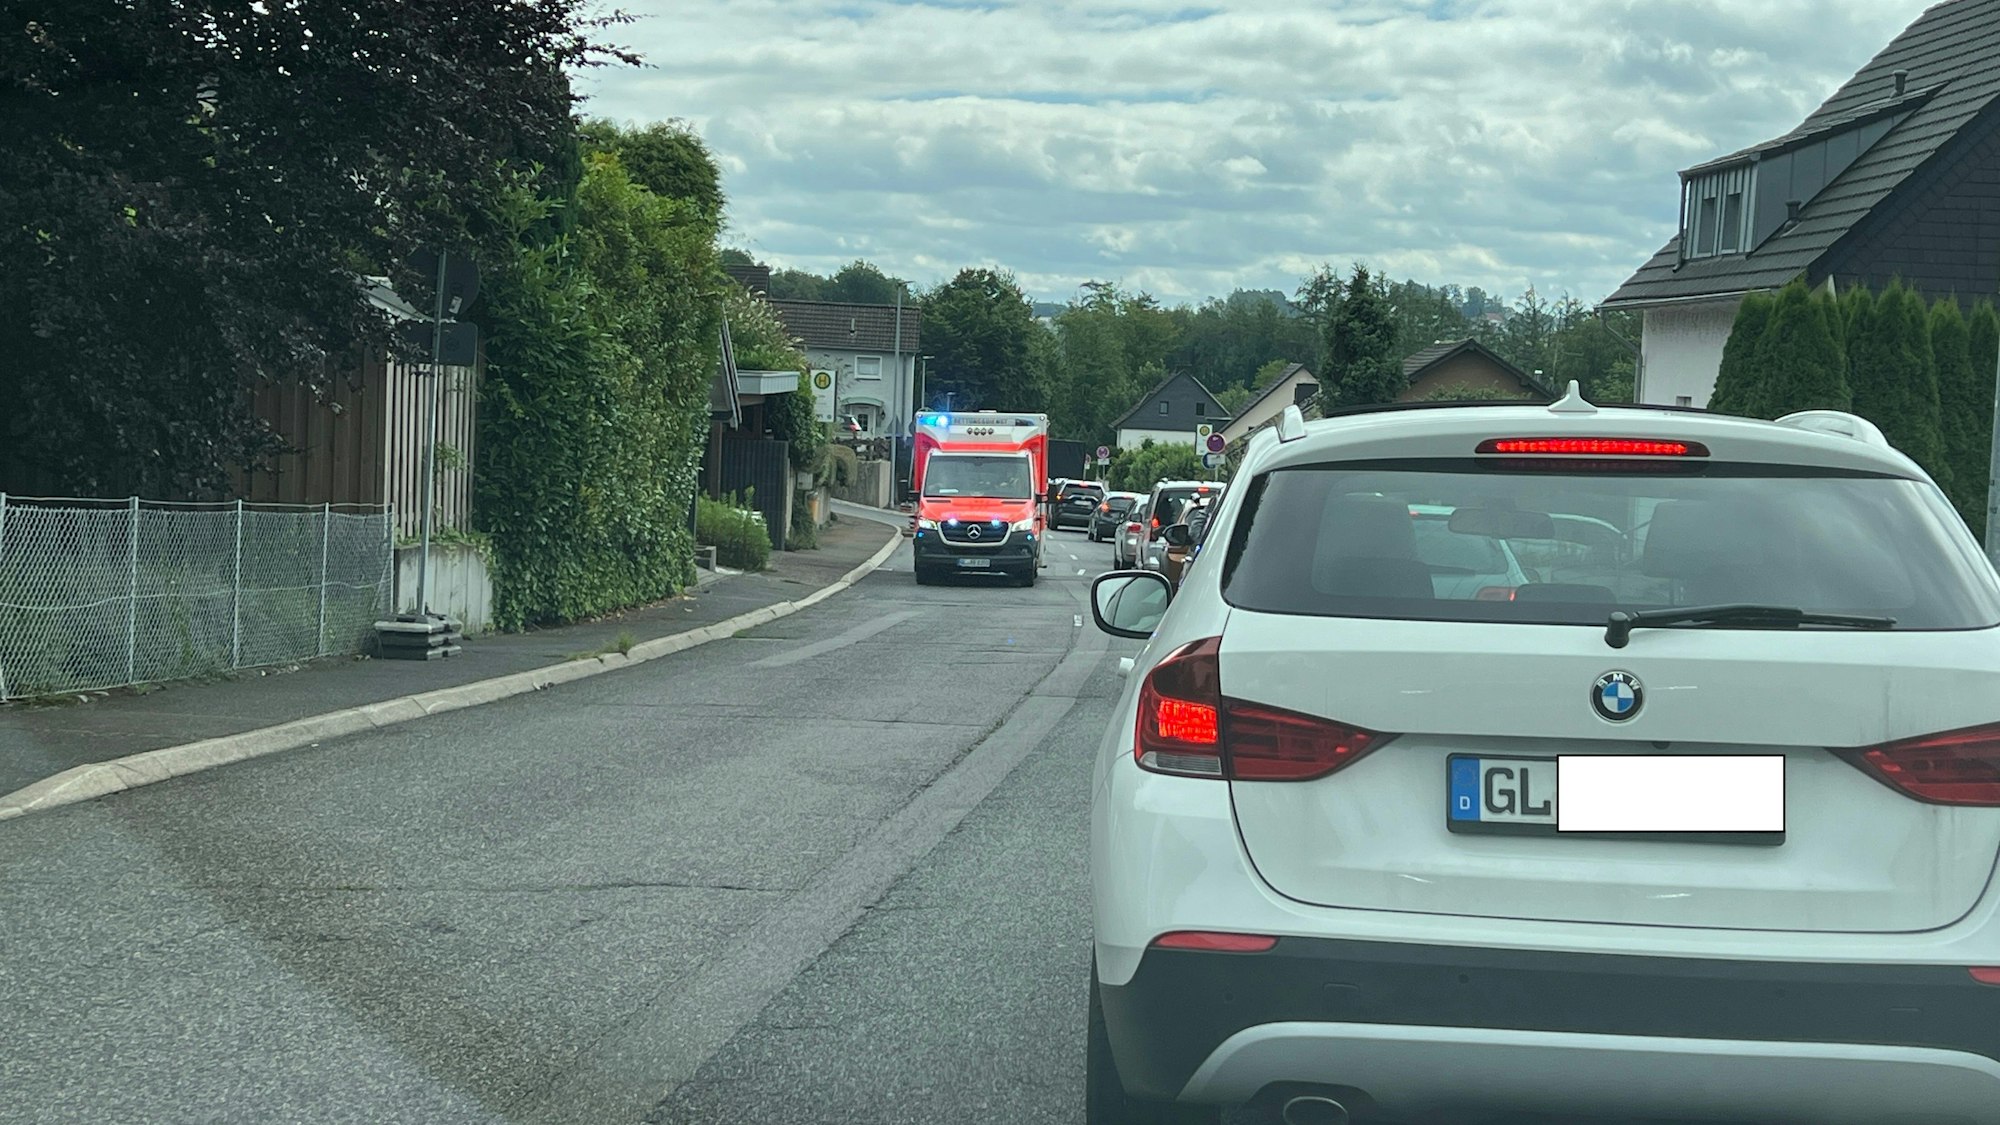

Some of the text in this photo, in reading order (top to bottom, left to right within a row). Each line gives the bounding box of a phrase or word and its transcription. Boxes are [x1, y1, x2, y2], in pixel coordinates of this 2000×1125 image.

[819, 375, 827, 386] H
[1597, 673, 1641, 690] BMW
[1485, 767, 1551, 815] GL
[1460, 796, 1470, 810] D
